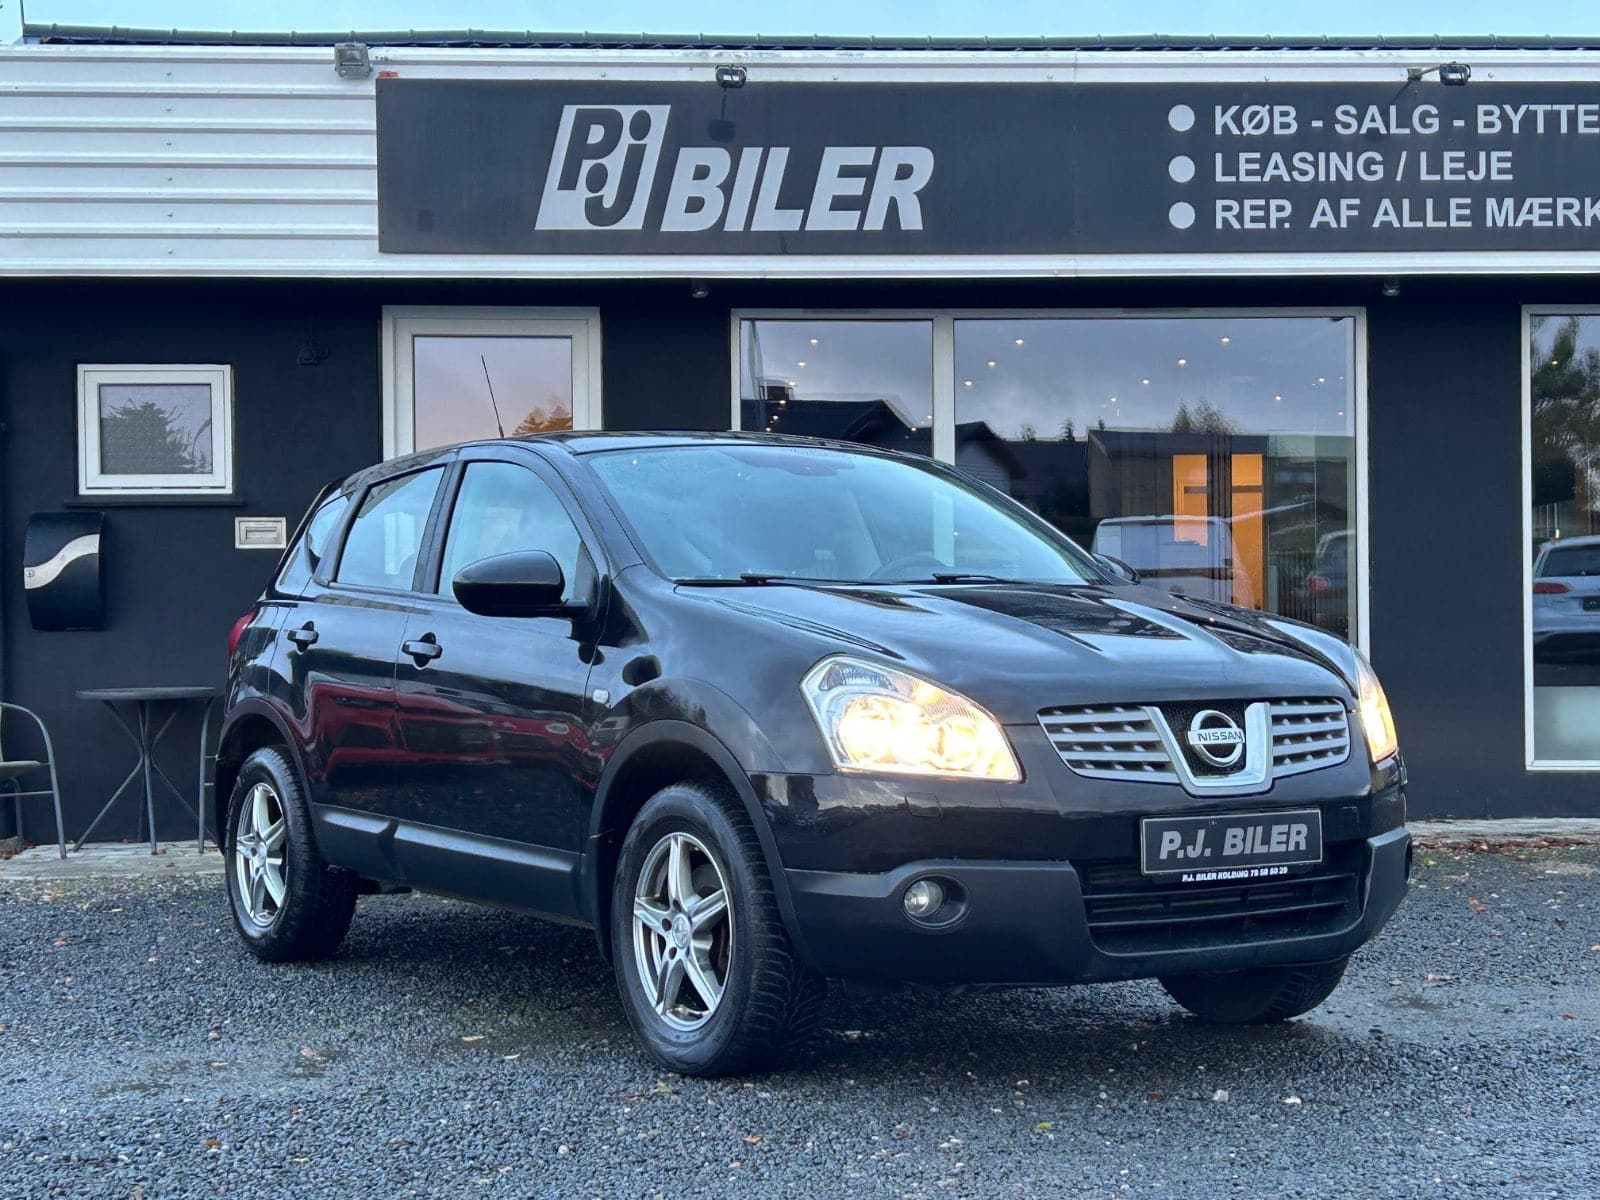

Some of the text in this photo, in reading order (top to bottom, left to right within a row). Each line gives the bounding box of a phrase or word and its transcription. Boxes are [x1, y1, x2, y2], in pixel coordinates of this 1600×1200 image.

[1213, 104, 1299, 137] KØB
[1334, 104, 1441, 135] SALG
[1476, 103, 1600, 134] BYTTE
[1214, 151, 1384, 183] LEASING
[1419, 151, 1514, 182] LEJE
[660, 146, 935, 232] BILER
[1215, 199, 1292, 230] REP.
[1309, 198, 1360, 229] AF
[1371, 197, 1473, 228] ALLE
[1197, 730, 1243, 742] NISSAN
[1159, 823, 1309, 860] P.J. BILER
[1195, 872, 1217, 881] BILER
[1217, 870, 1249, 880] KOLDING
